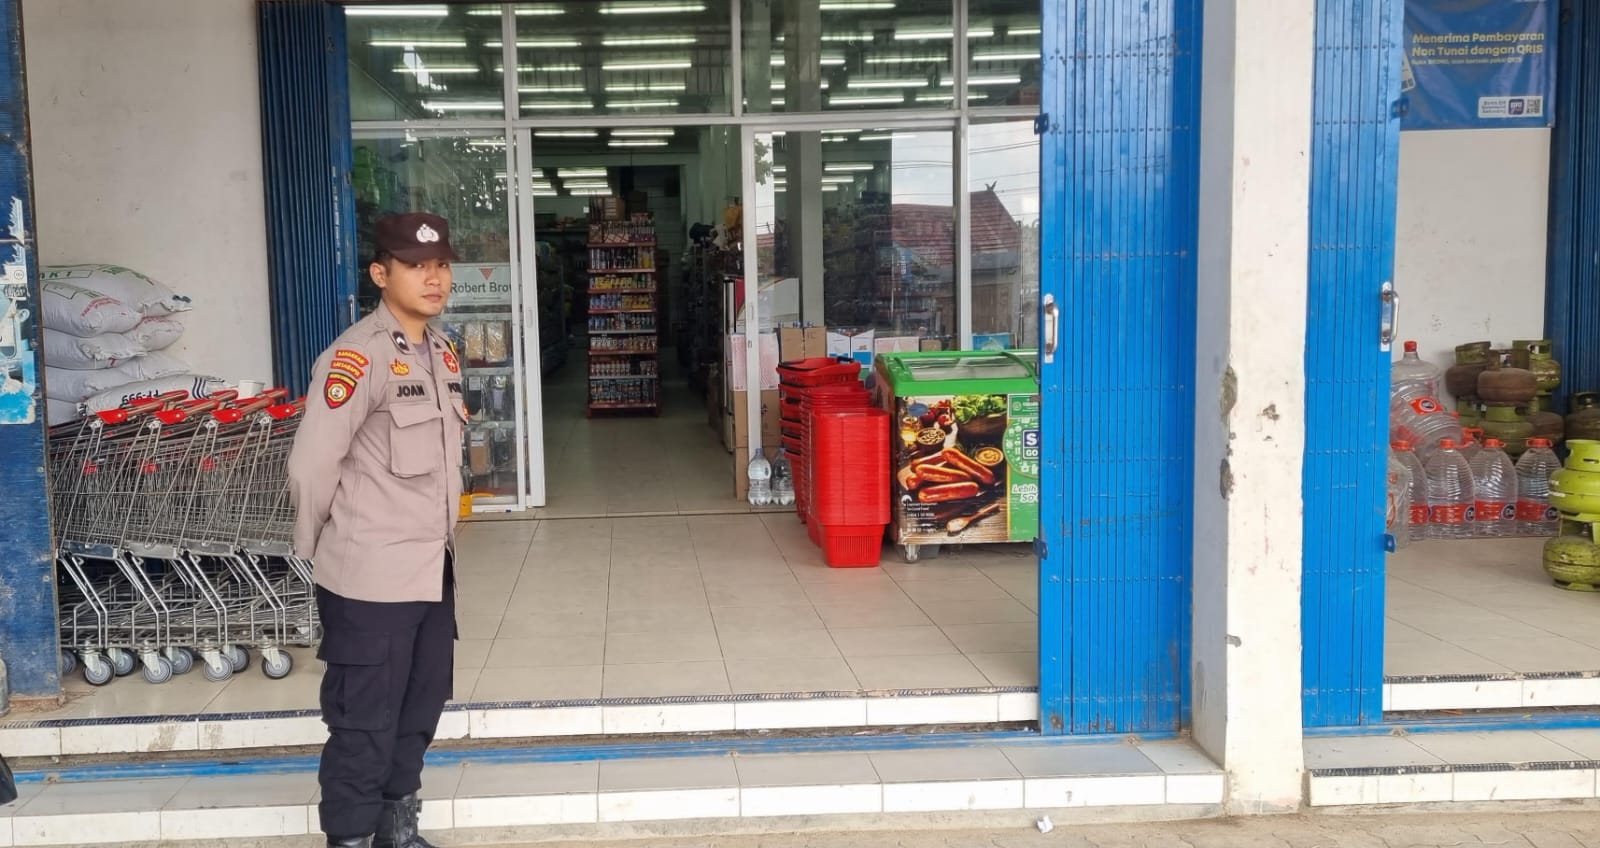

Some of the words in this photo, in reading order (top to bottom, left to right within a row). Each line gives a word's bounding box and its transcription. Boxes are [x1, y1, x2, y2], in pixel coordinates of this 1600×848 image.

[1412, 32, 1470, 43] Menerima
[1472, 32, 1545, 43] Pembayaran
[1412, 46, 1436, 57] Non
[1437, 46, 1469, 56] Tunai
[1470, 45, 1515, 57] dengan
[1516, 44, 1544, 54] QRIS
[450, 282, 486, 293] Robert
[396, 384, 425, 397] JOAN
[1026, 433, 1038, 446] S
[1012, 483, 1038, 494] Lebih
